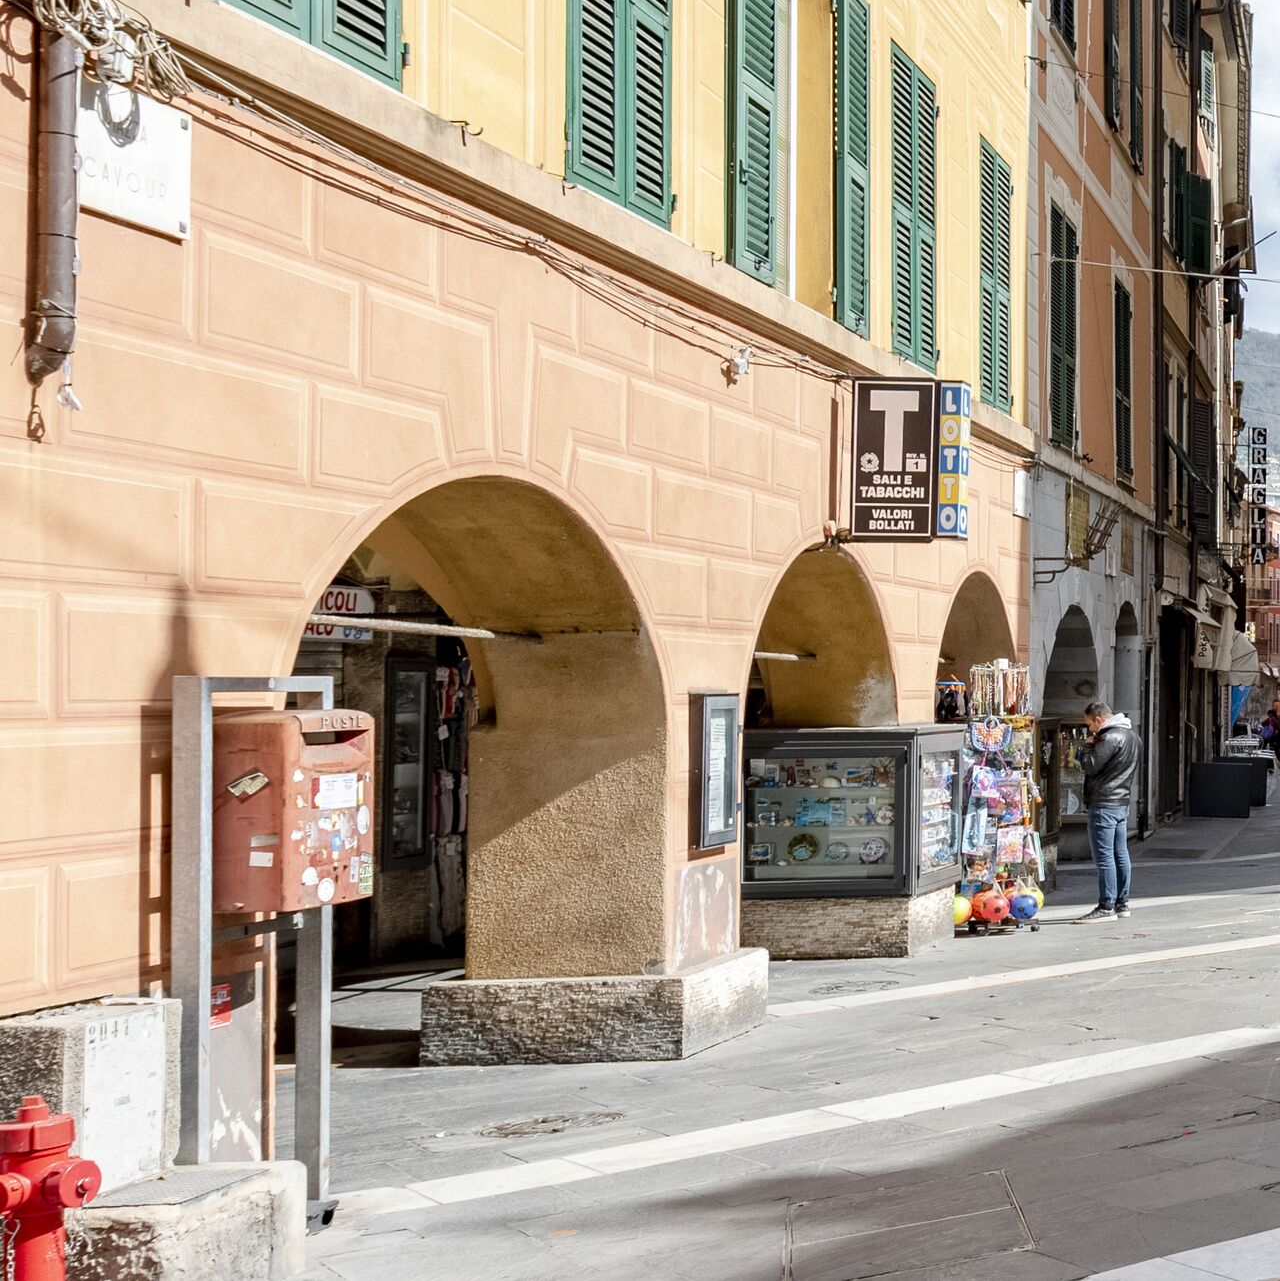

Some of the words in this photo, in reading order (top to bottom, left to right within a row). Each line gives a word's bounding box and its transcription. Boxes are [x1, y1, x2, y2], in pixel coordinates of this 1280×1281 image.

[84, 156, 168, 203] CAVOUR
[869, 390, 920, 472] T
[939, 389, 960, 530] LOTTO
[872, 474, 901, 485] SALI
[904, 475, 913, 485] E
[860, 486, 925, 499] TABACCHI
[1252, 427, 1267, 564] GRAGLIA
[871, 508, 912, 519] VALORI
[868, 520, 915, 530] BOLLATI
[322, 715, 363, 729] POSTE
